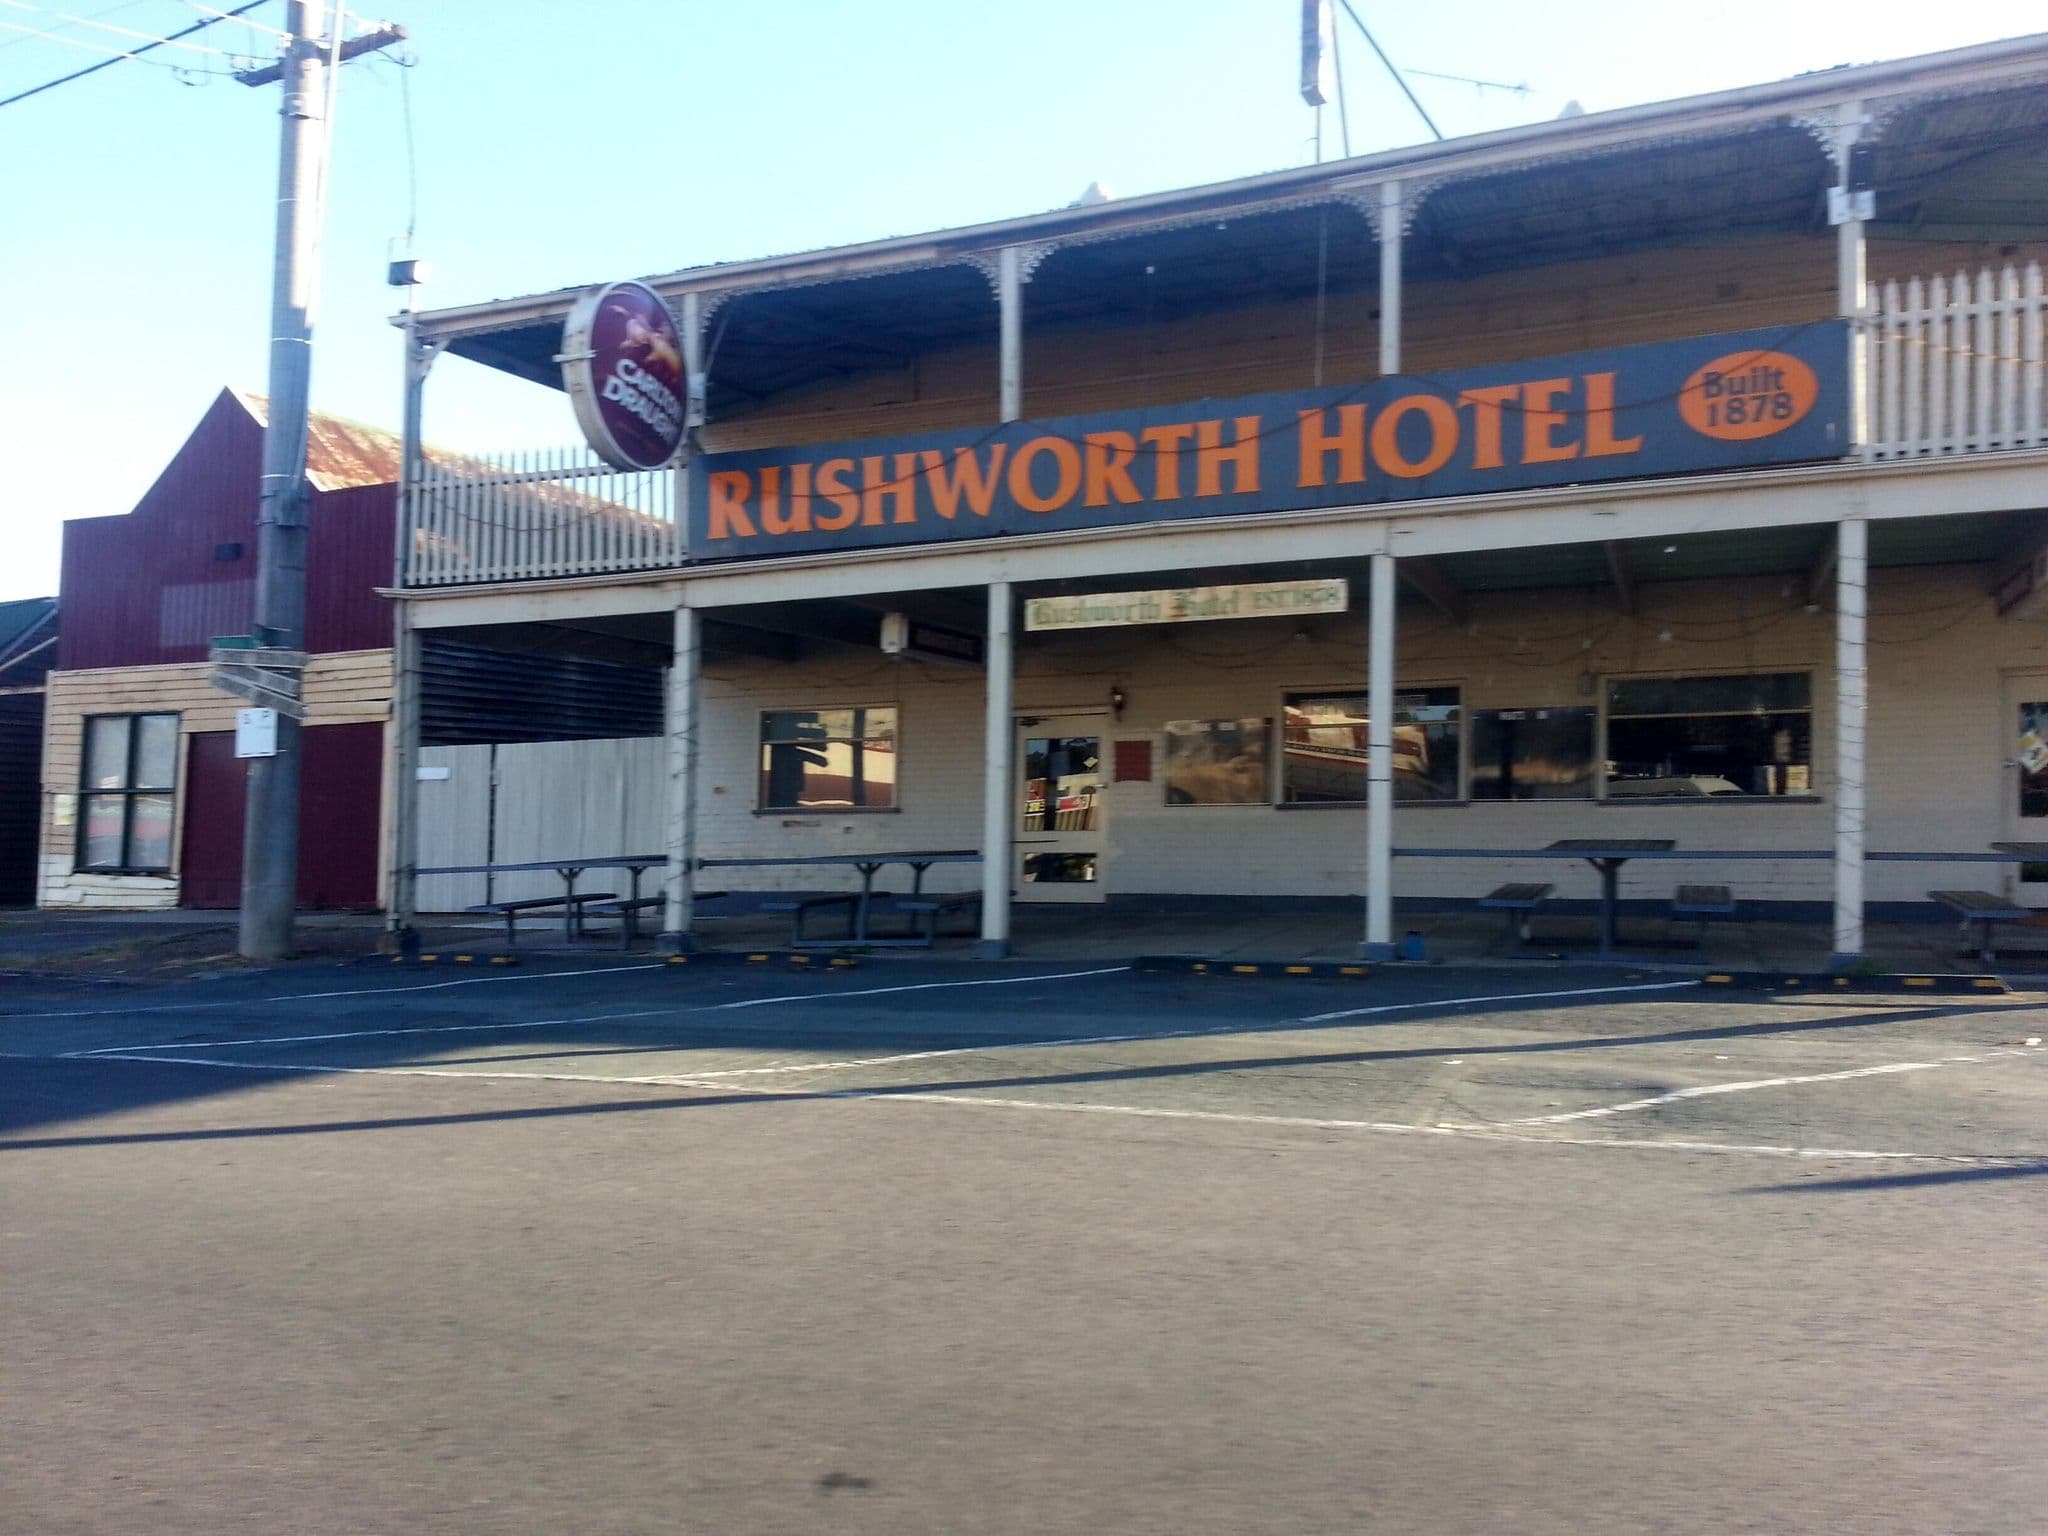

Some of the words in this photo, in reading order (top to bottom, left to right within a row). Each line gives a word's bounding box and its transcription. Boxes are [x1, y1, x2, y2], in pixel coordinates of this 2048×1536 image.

[1703, 366, 1784, 398] Built
[1706, 392, 1792, 427] 1878
[707, 415, 1261, 540] RUSHWORTH
[1296, 373, 1644, 488] HOTEL
